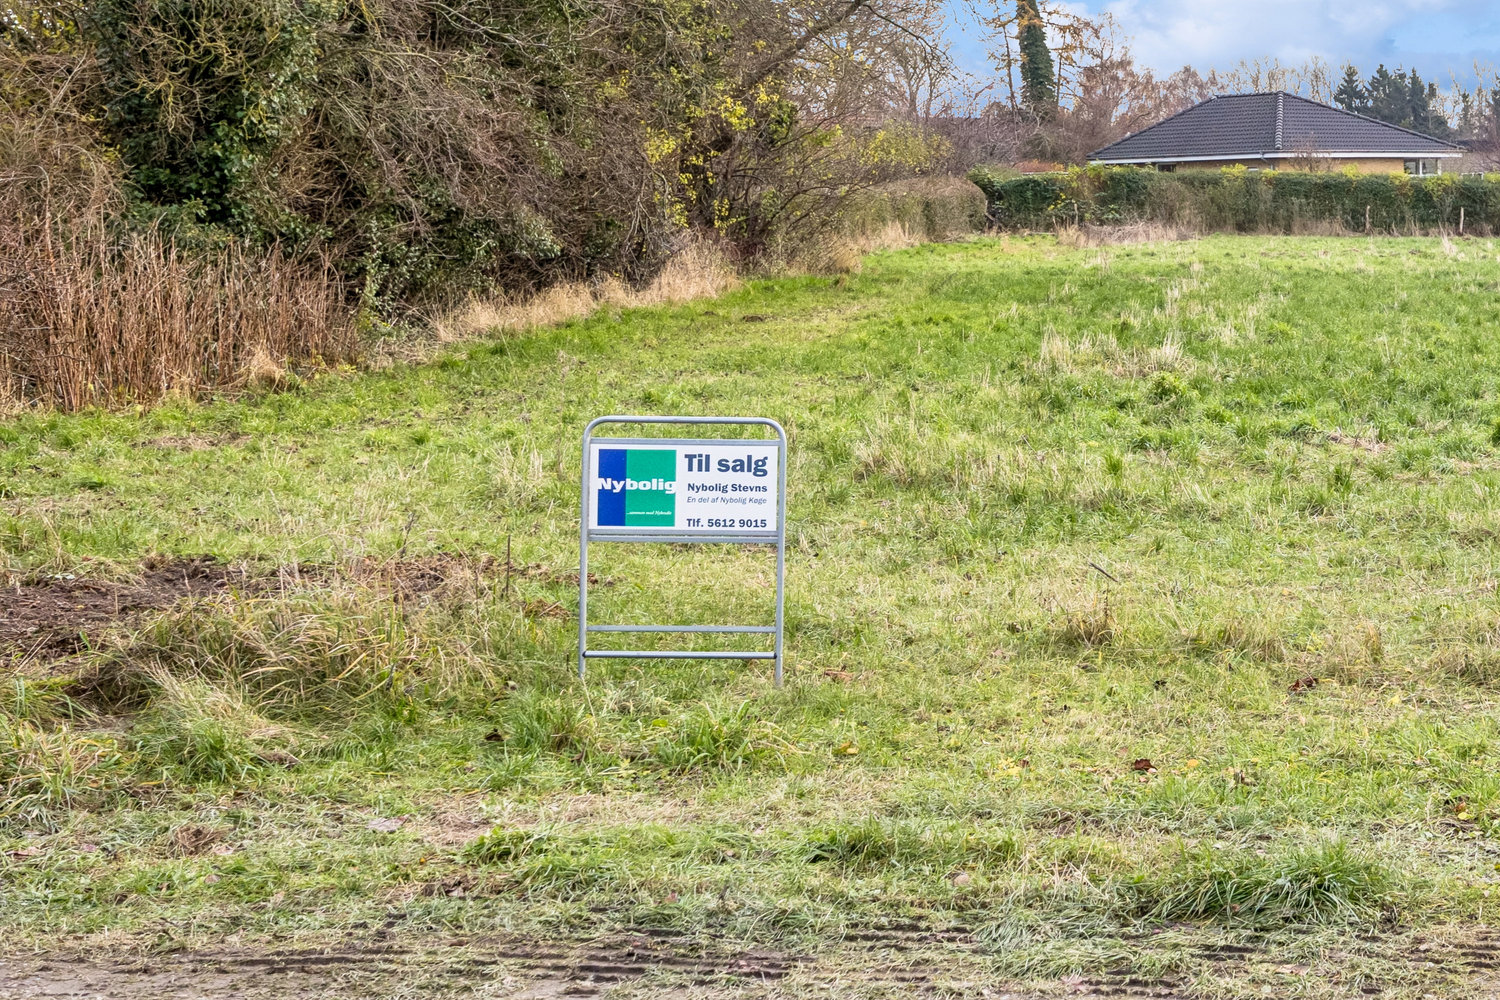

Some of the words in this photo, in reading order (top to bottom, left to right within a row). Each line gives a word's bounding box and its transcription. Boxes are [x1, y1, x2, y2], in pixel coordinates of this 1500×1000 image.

[684, 454, 711, 472] Til
[717, 454, 768, 477] salg
[598, 478, 677, 494] Nybolig
[687, 483, 728, 493] Nybolig
[731, 484, 768, 492] Stevns
[720, 497, 747, 505] Nybolig
[748, 497, 767, 505] Køge
[686, 518, 704, 527] Tlf.
[707, 519, 735, 528] 5612
[739, 519, 767, 528] 9015
